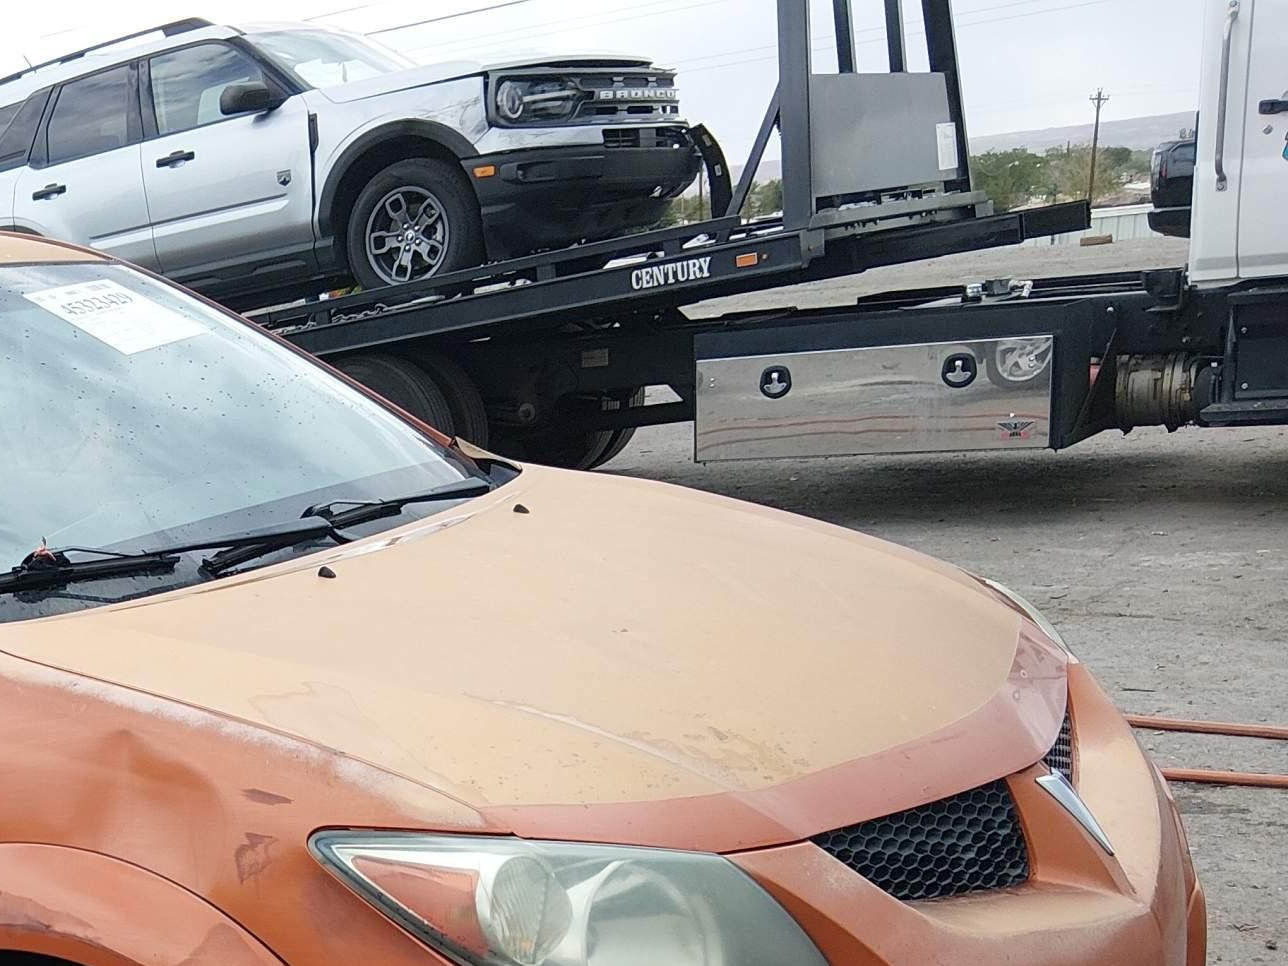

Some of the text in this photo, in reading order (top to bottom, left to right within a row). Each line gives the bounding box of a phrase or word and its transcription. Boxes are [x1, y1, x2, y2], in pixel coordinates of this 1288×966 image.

[599, 89, 675, 100] BRONCO
[631, 256, 711, 290] CENTURY
[60, 292, 133, 315] 45323429
